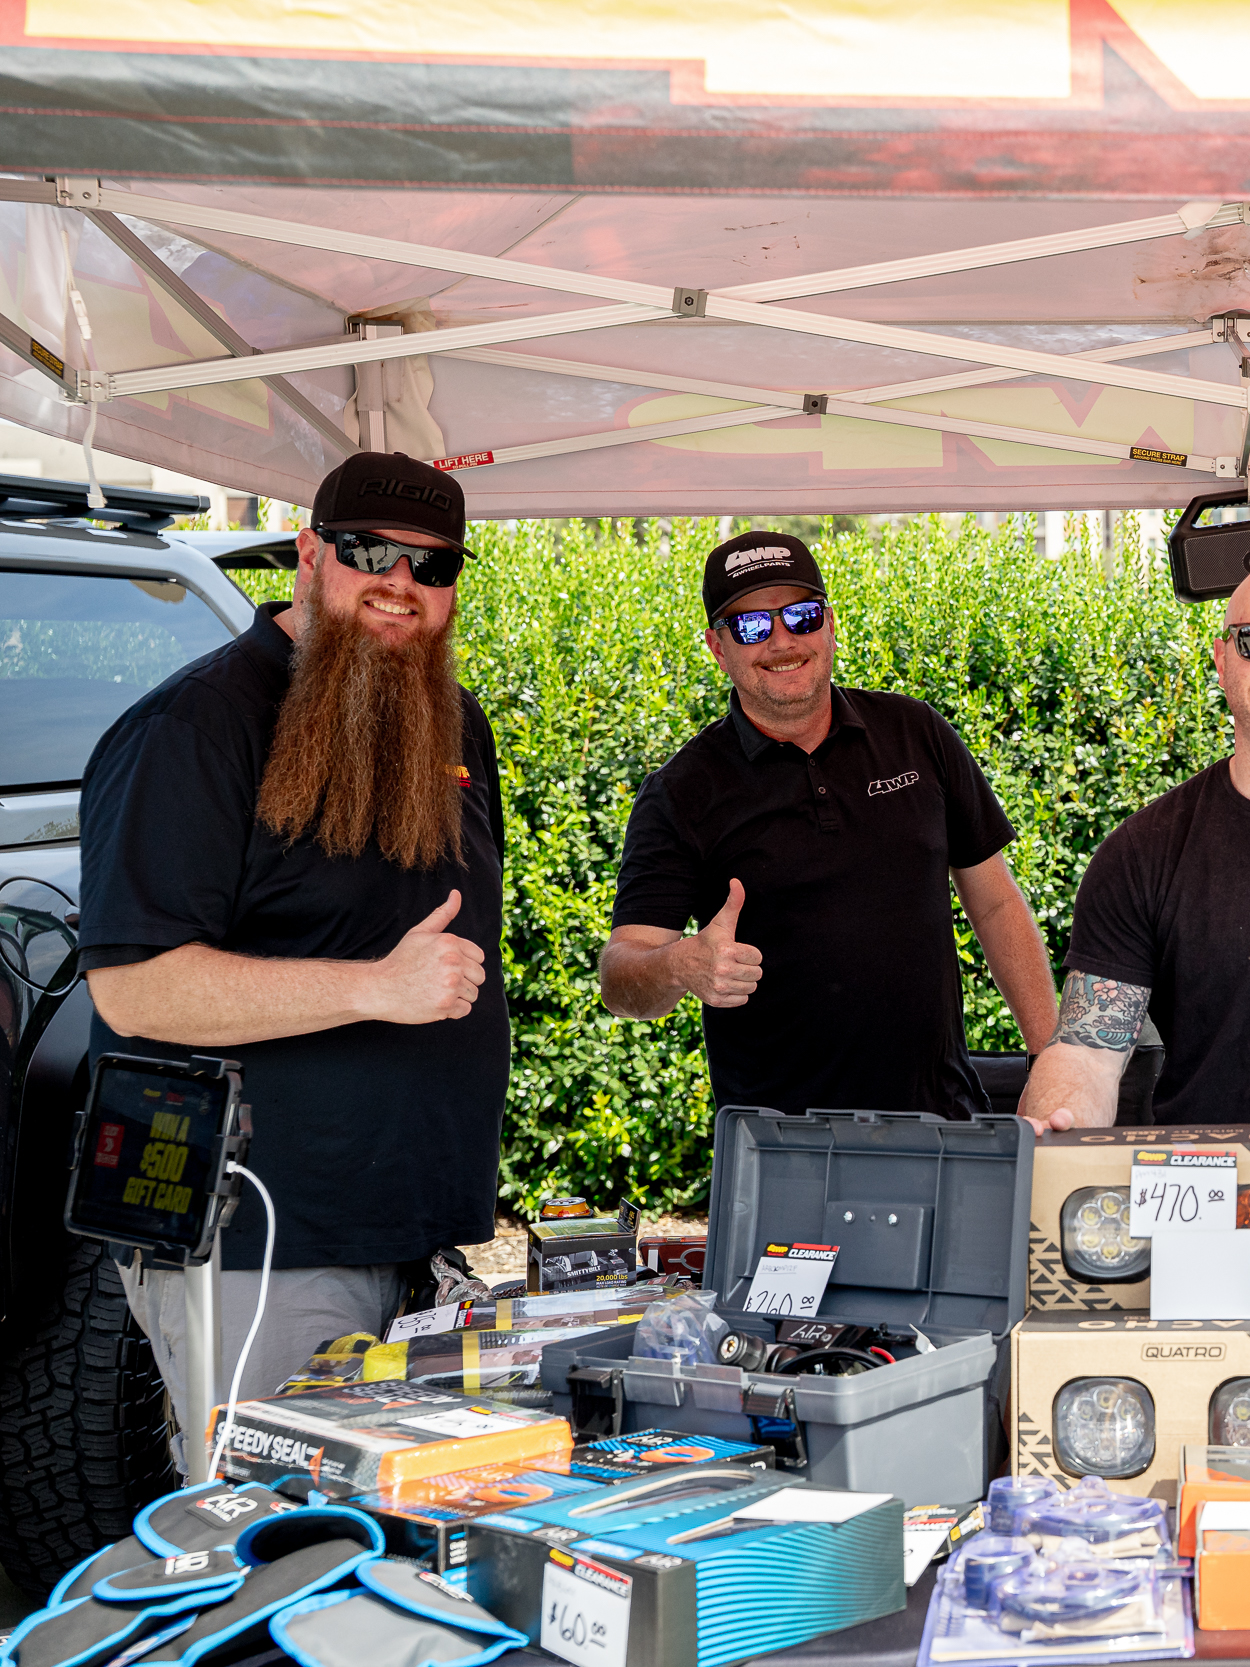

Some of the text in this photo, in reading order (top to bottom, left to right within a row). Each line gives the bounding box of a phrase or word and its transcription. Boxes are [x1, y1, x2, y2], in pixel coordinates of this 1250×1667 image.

[439, 452, 489, 468] LIFT HERE
[1132, 448, 1186, 461] SECURE STRAP
[358, 478, 453, 511] RIGID
[725, 546, 791, 571] 4WP
[868, 771, 919, 797] 4WP
[150, 1111, 181, 1141] WIN
[176, 1116, 190, 1143] A
[139, 1141, 189, 1183] $500
[1170, 1155, 1237, 1167] CLEARANCE
[122, 1176, 193, 1214] GIFT CARD
[788, 1249, 837, 1261] CLEARANCE
[567, 1265, 601, 1278] SMITTYBILT
[596, 1274, 618, 1282] 20,000
[1145, 1345, 1223, 1359] QUATRO
[215, 1420, 311, 1467] SPEEDY SEAL
[574, 1563, 629, 1598] CLEARANCE
